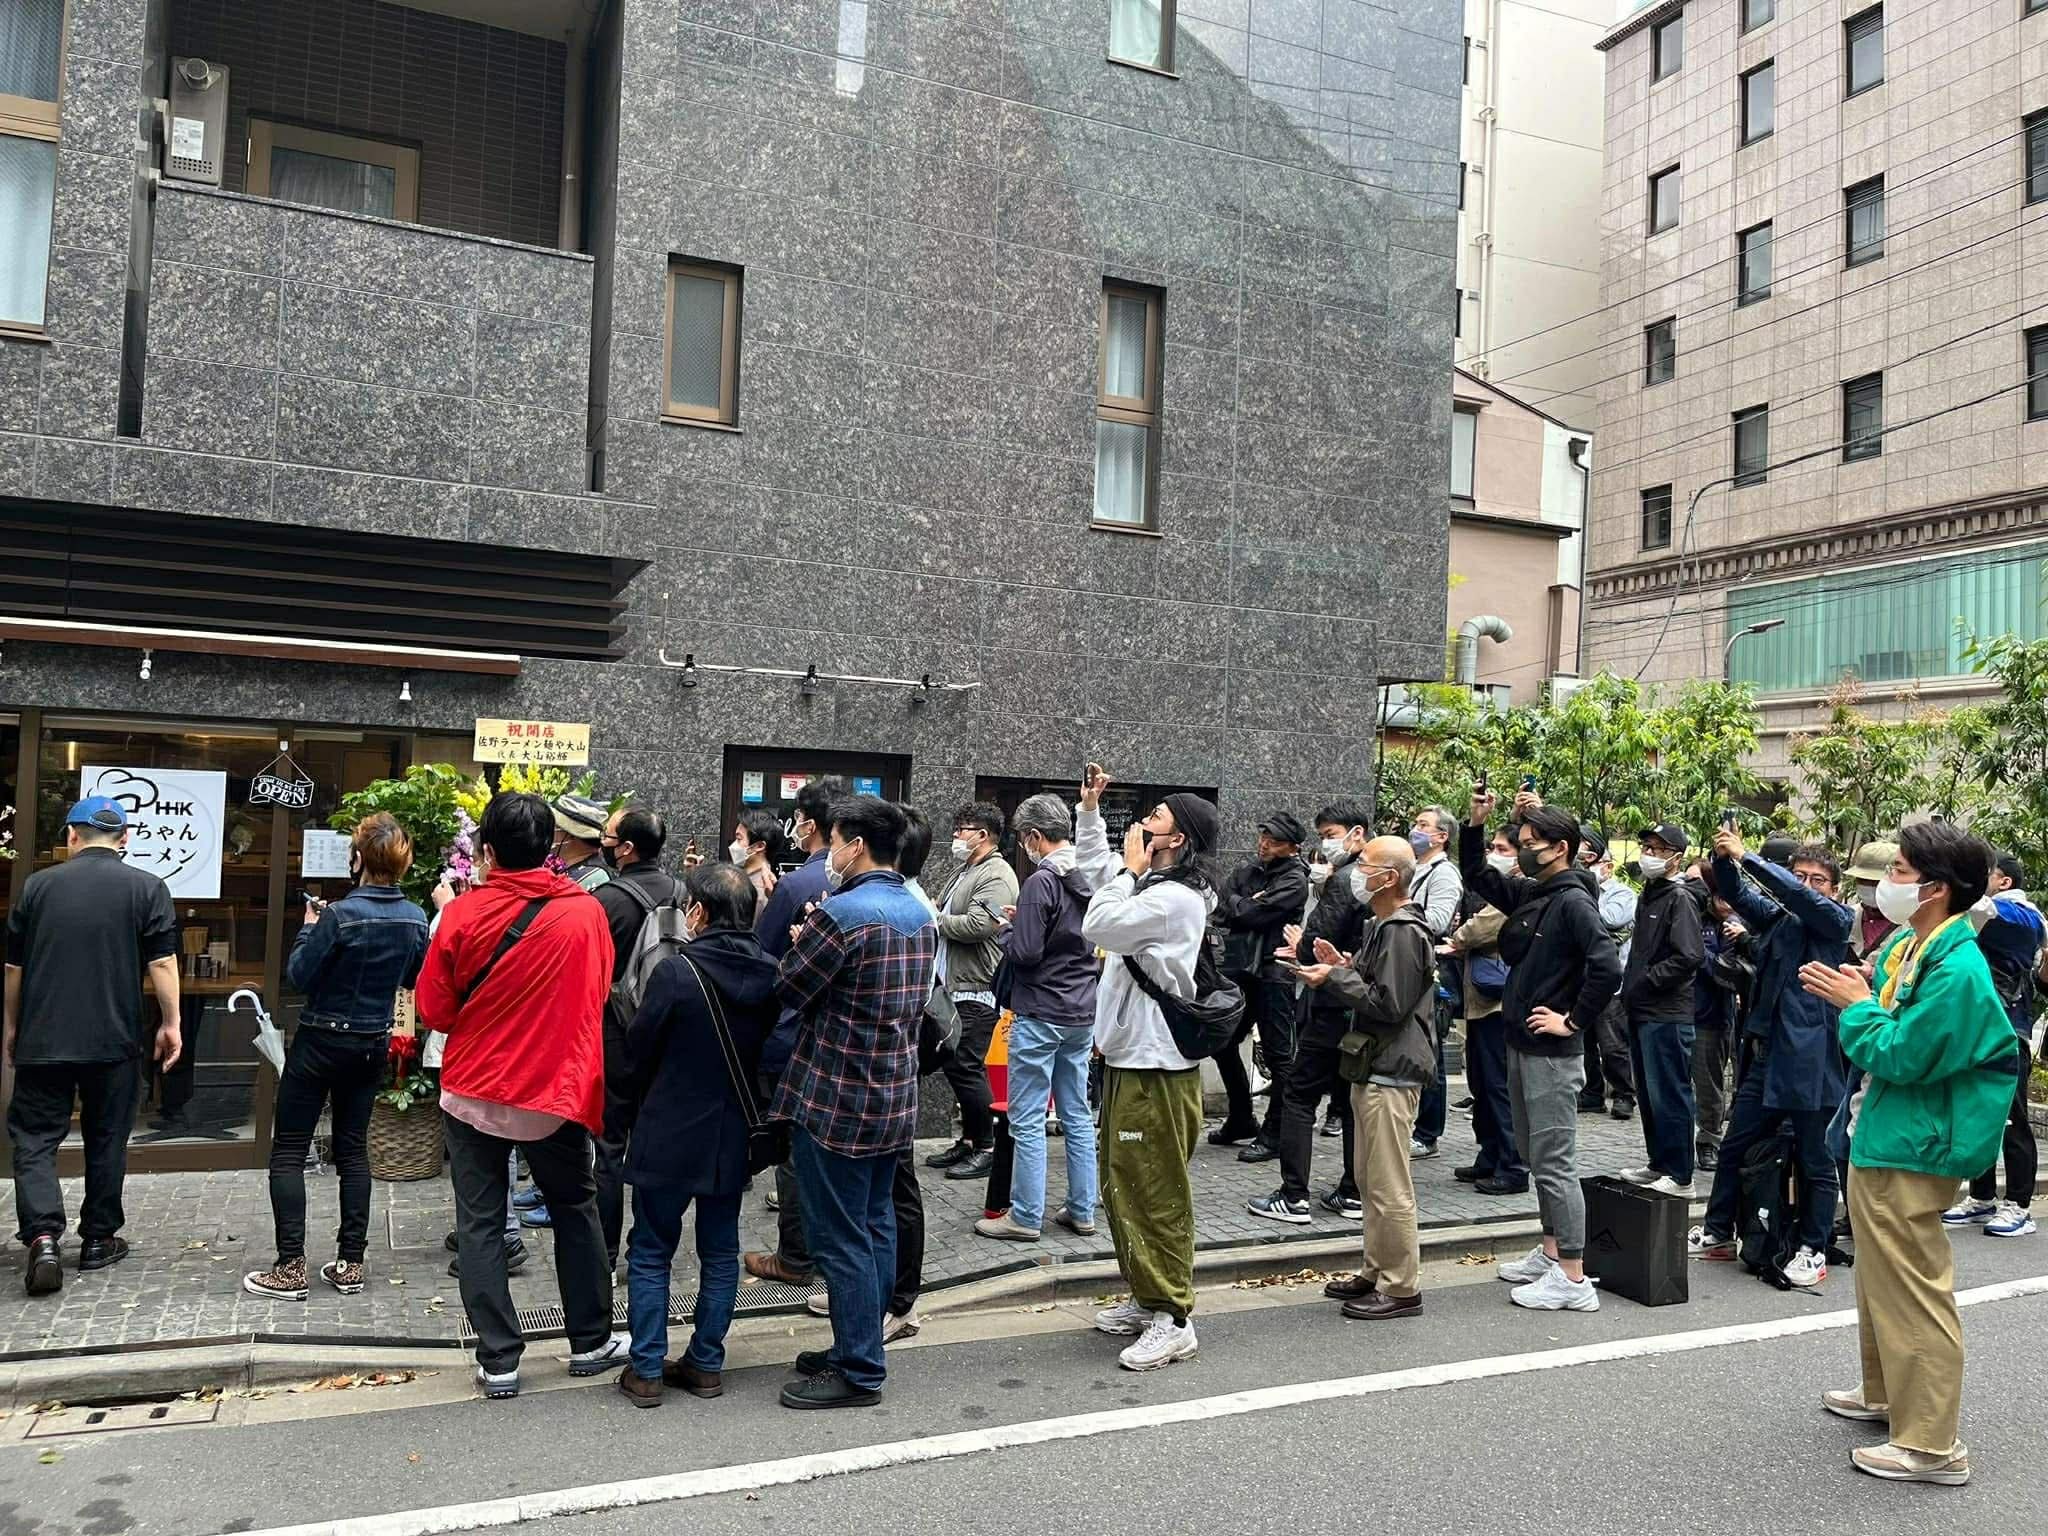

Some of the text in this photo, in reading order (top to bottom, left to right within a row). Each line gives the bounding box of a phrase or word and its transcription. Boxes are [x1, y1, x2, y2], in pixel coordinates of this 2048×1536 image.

[506, 722, 555, 738] 祝開店
[258, 782, 307, 805] OPEN
[127, 821, 199, 841] ちゃん
